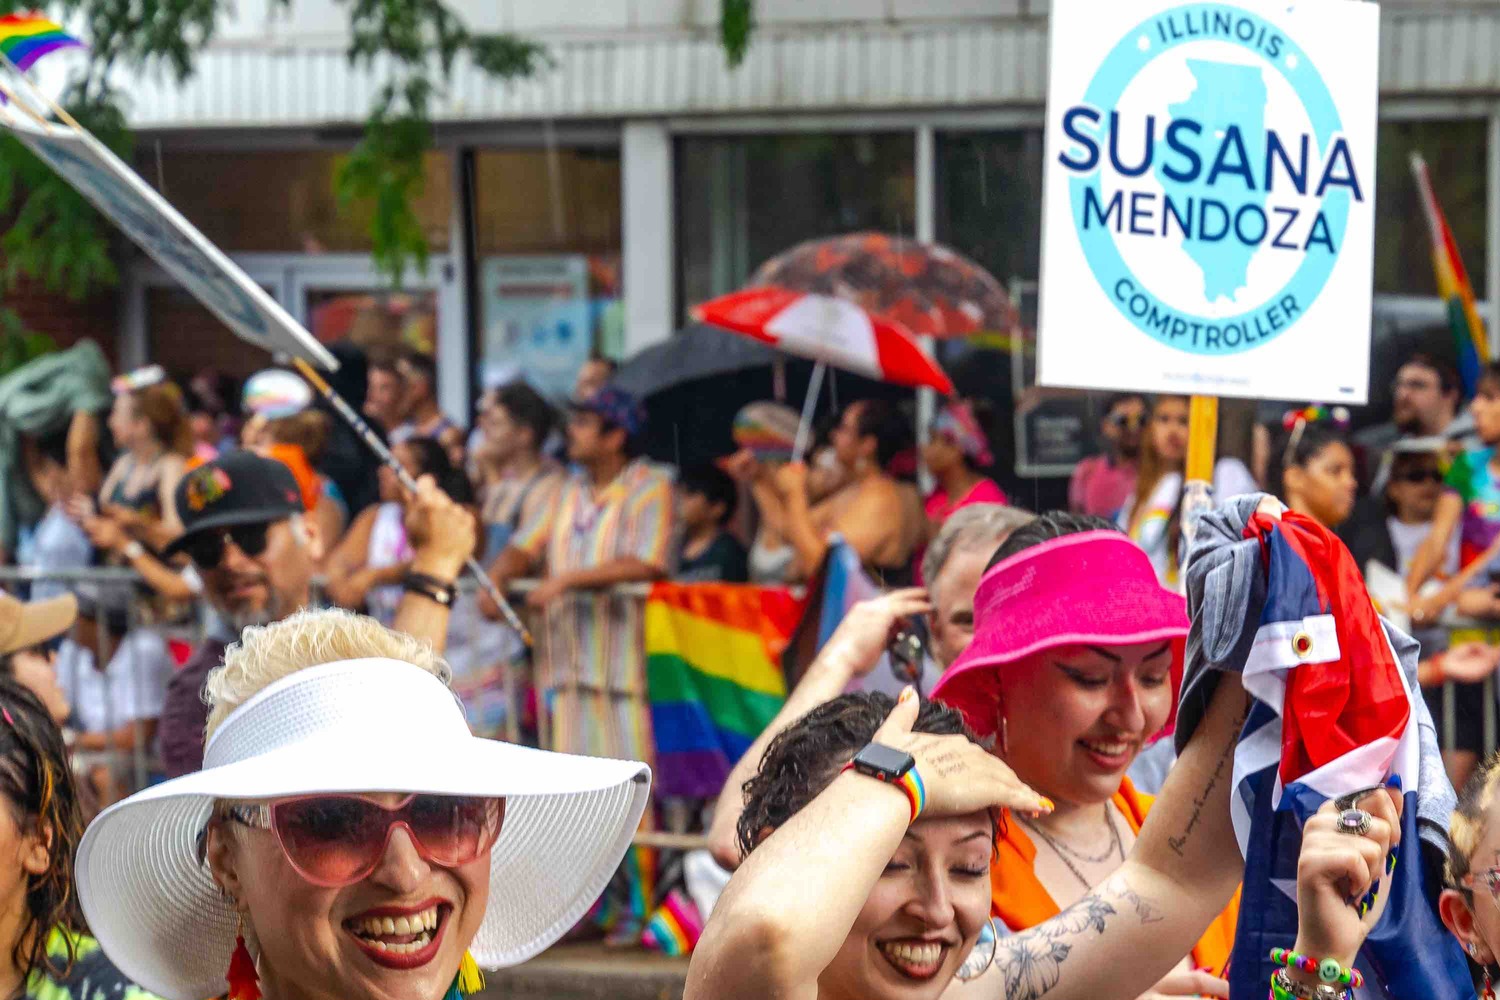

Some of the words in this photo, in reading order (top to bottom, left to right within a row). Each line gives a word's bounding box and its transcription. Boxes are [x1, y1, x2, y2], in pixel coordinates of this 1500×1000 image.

[1156, 10, 1284, 58] ILLINOIS
[1057, 105, 1364, 202] SUSANA
[1082, 186, 1336, 254] MENDOZA
[1114, 278, 1300, 348] COMPTROLLER
